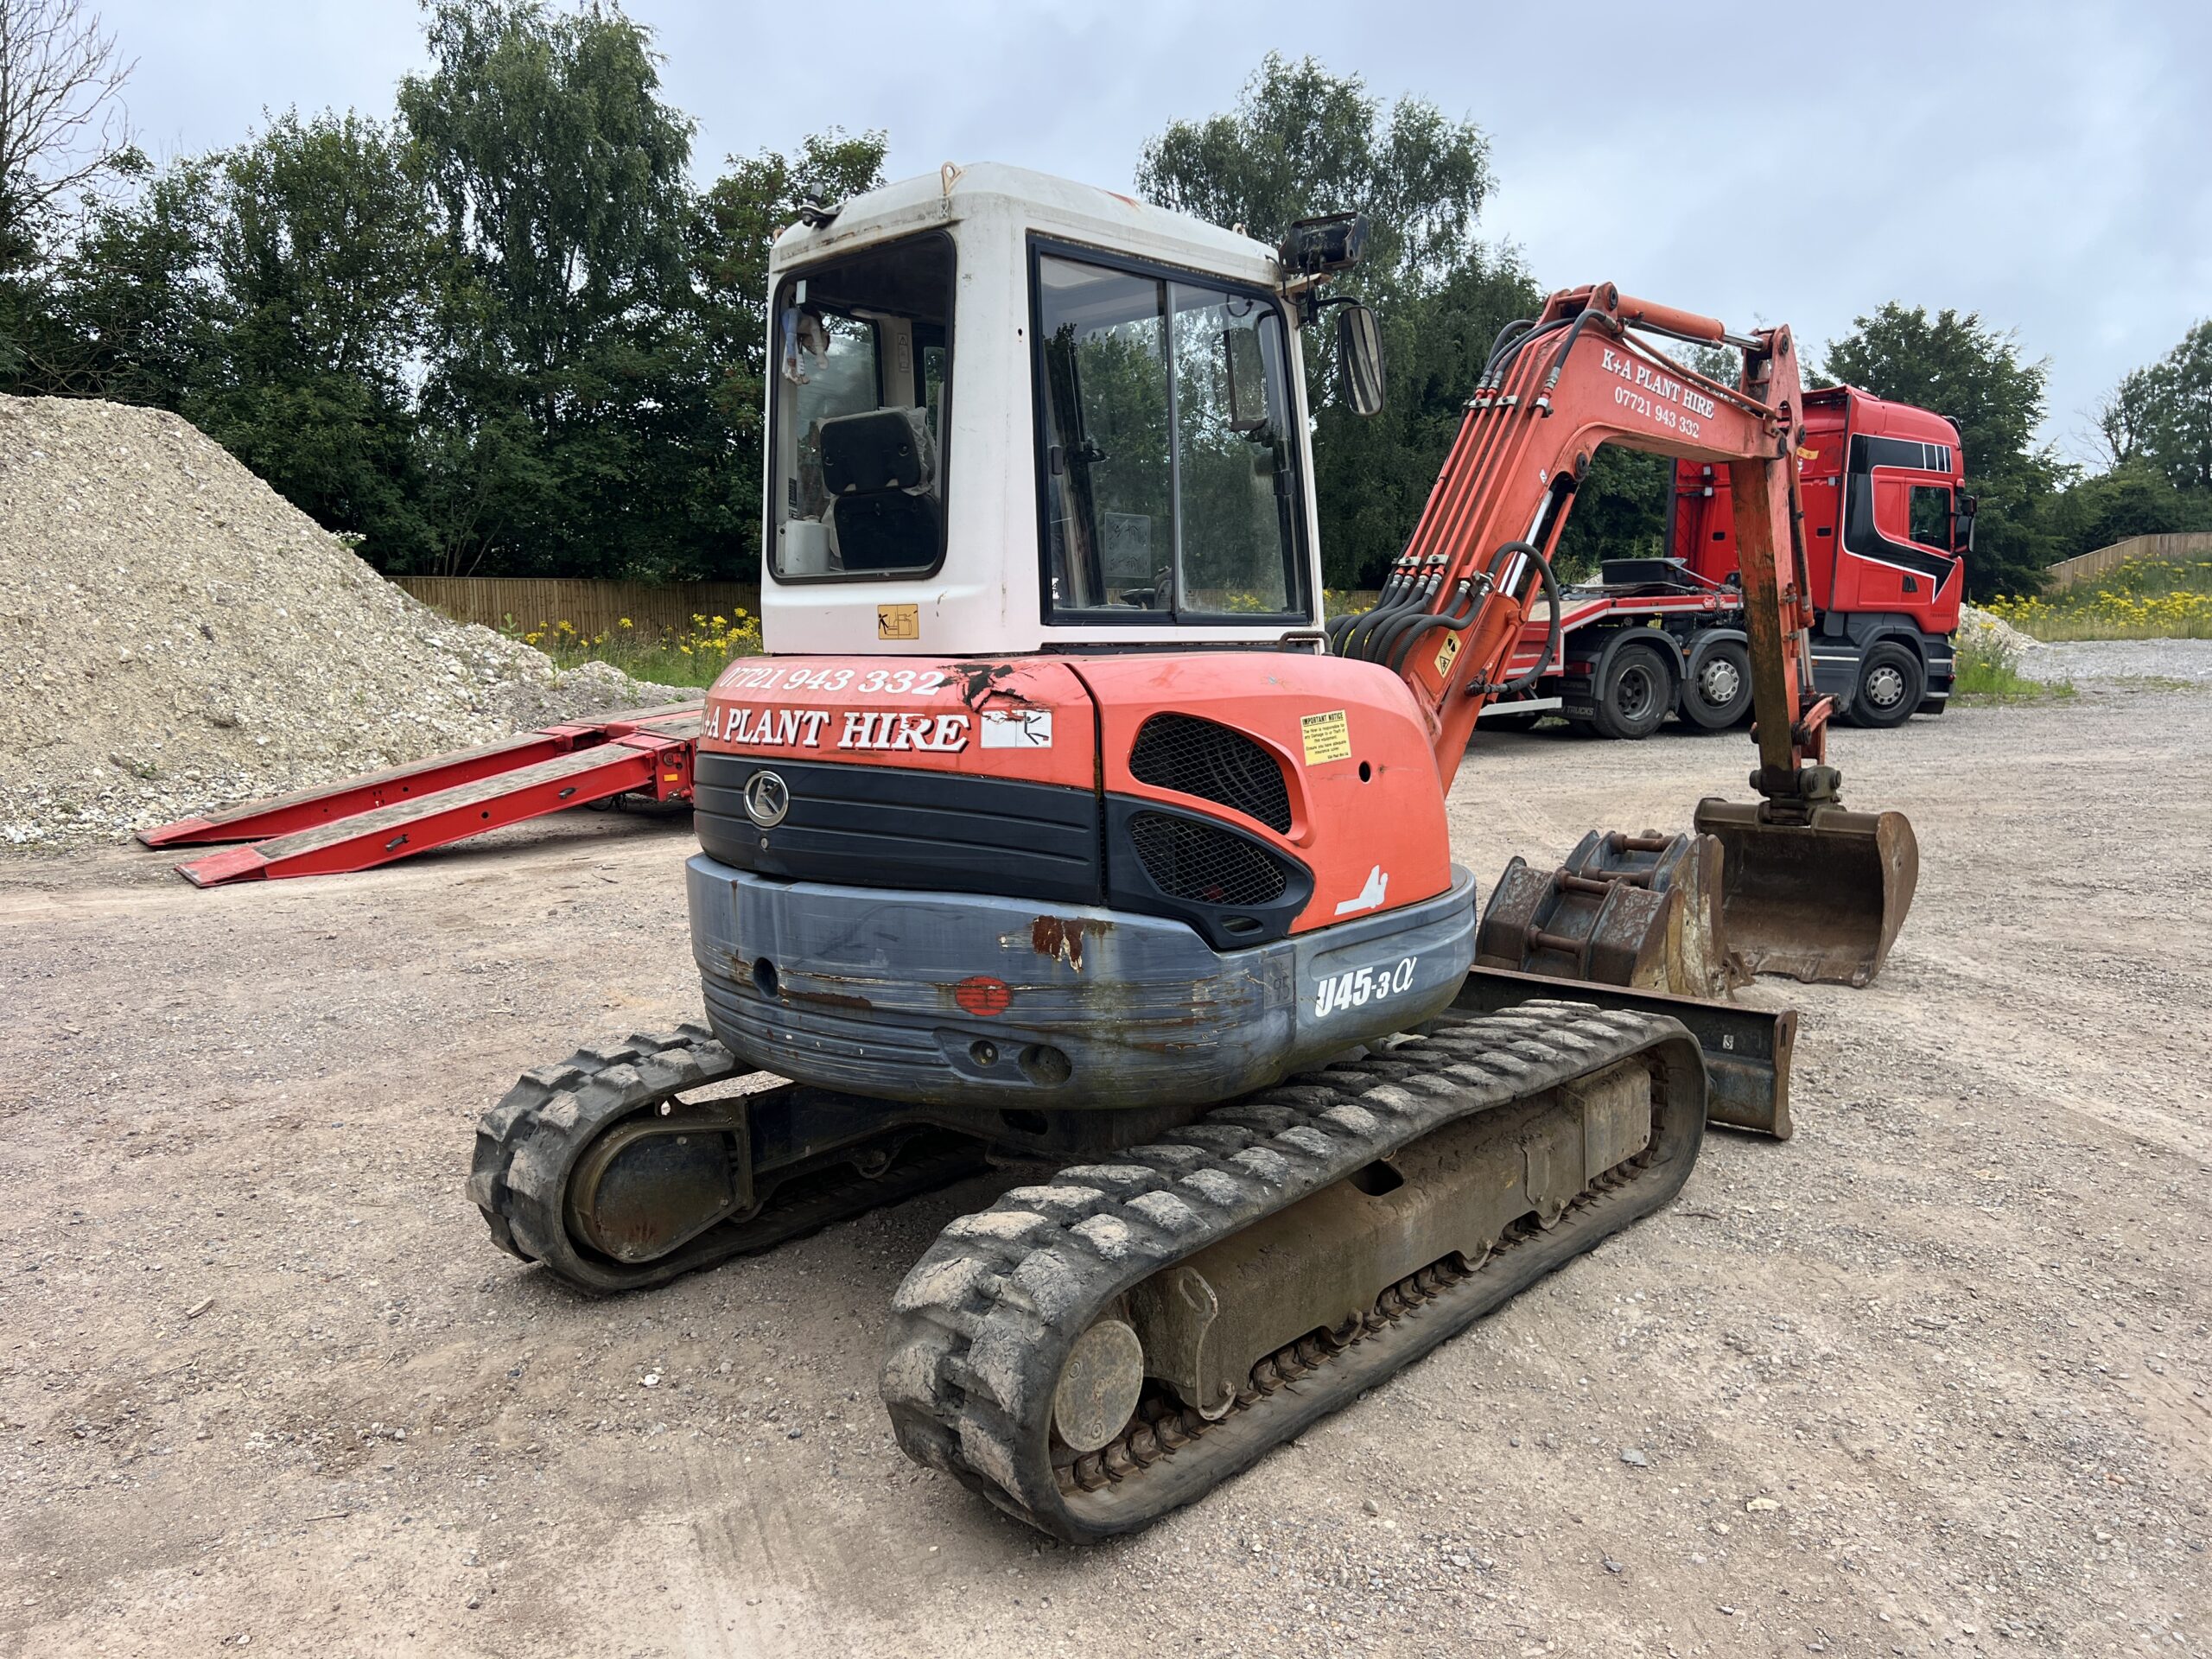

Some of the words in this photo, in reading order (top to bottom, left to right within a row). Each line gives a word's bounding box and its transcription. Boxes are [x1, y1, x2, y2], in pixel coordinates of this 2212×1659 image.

[1601, 348, 1632, 380] K+A
[1636, 364, 1681, 402] PLANT
[1681, 389, 1714, 420] HIRE
[1614, 386, 1651, 416] 07721
[1655, 404, 1676, 428] 943
[1679, 416, 1700, 438] 332
[719, 666, 786, 689] 07721
[782, 669, 855, 691] 943
[858, 670, 945, 696] 332
[723, 708, 830, 747] PLANT
[837, 711, 972, 753] HIRE
[1302, 715, 1327, 725] IMPORTANT
[1328, 712, 1343, 721] NOTICE
